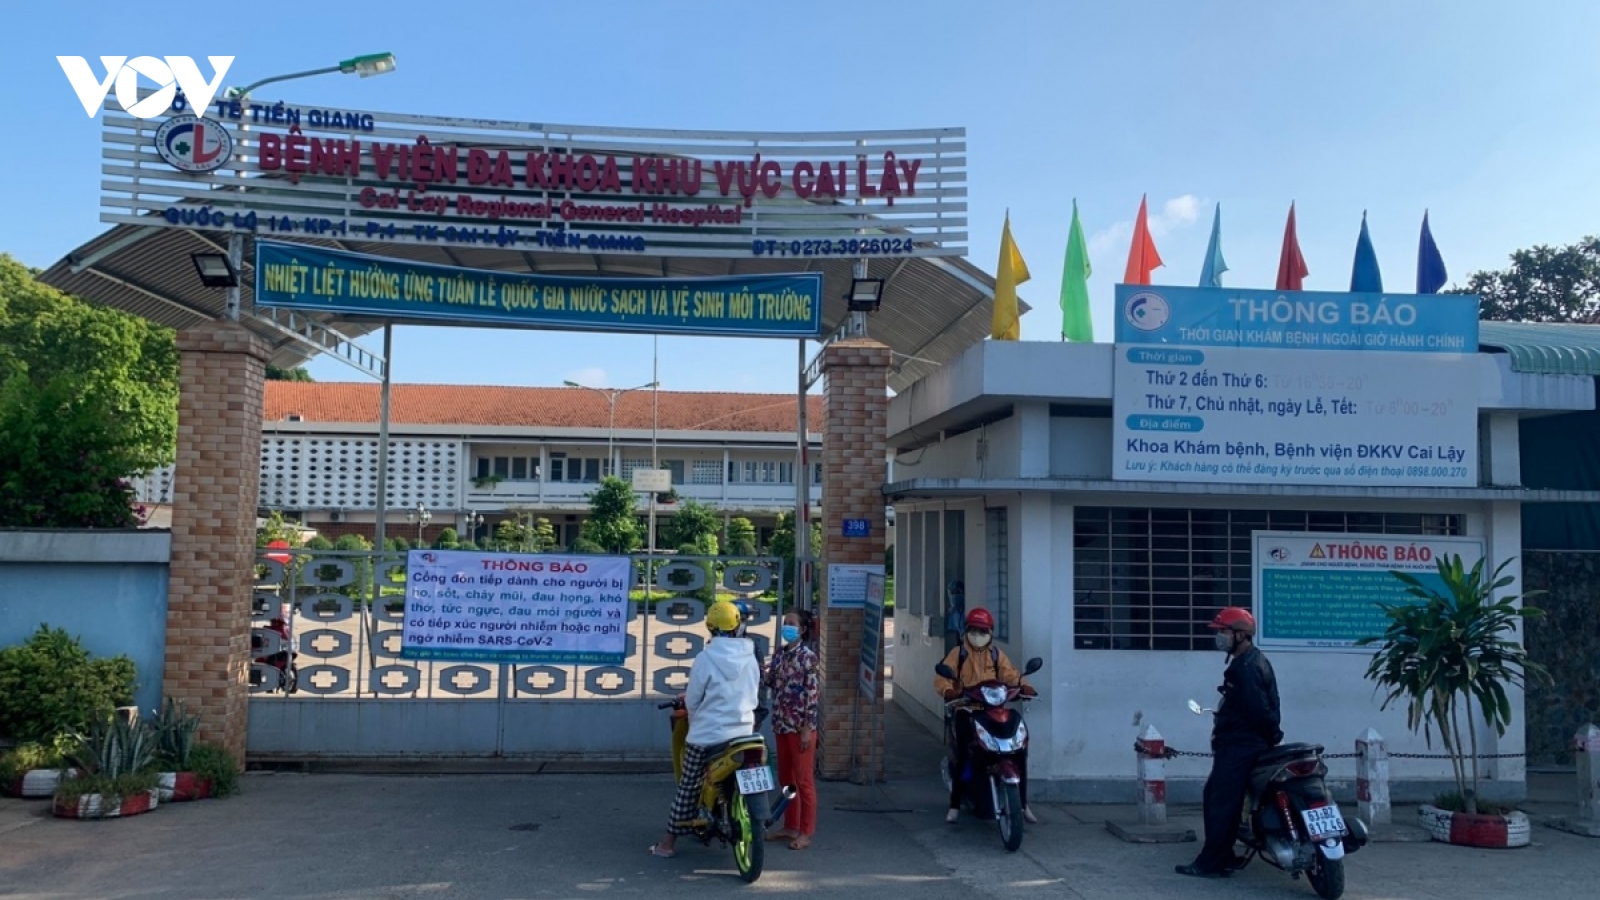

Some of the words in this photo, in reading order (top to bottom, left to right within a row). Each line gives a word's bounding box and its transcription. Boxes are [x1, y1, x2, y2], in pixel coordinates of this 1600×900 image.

[308, 109, 374, 131] GIANG
[258, 125, 361, 185] BỆNH
[372, 134, 457, 193] VIỆN
[526, 152, 621, 193] KHOA
[632, 156, 702, 195] KHU
[714, 153, 782, 208] VỰC
[792, 160, 847, 198] CAI
[858, 151, 922, 207] LẬY
[359, 186, 400, 208] Cai
[407, 190, 450, 216] Lay
[457, 194, 552, 219] Regional
[560, 200, 644, 222] General
[652, 203, 742, 227] Hospital
[164, 205, 226, 228] QUỐC
[587, 233, 645, 251] GIANG
[264, 258, 308, 299] NHIỆT
[312, 262, 345, 302] LIỆT
[350, 263, 400, 300] HƯỞNG
[502, 278, 538, 312] QUỐC
[543, 286, 565, 310] GIA
[570, 283, 607, 313] NƯỚC
[611, 289, 647, 320] SẠCH
[651, 285, 669, 316] VÀ
[672, 286, 690, 322] VỆ
[693, 290, 725, 319] SINH
[728, 286, 754, 320] MÔI
[758, 286, 812, 321] TRƯỜNG
[1228, 294, 1340, 324] THÔNG
[1351, 298, 1417, 326] BÁO
[1213, 328, 1243, 342] GIAN
[1246, 329, 1282, 344] KHÁM
[1286, 331, 1319, 347] BỆNH
[1139, 351, 1165, 361] Thời
[1167, 353, 1193, 363] gian
[1146, 370, 1175, 386] Thứ
[1179, 372, 1188, 386] 2
[1191, 369, 1218, 387] đến
[1222, 372, 1251, 388] Thứ
[1255, 374, 1268, 388] 6:
[1146, 394, 1175, 409] Thứ
[1180, 396, 1192, 412] 7,
[1195, 395, 1225, 412] Chủ
[1229, 398, 1264, 416] nhật,
[1268, 401, 1303, 417] ngày
[1331, 396, 1357, 414] Tết:
[1139, 418, 1159, 429] Địa
[1162, 417, 1191, 430] điểm
[1127, 438, 1169, 454] Khoa
[1174, 440, 1220, 455] Khám
[1225, 441, 1269, 459] bệnh,
[1275, 442, 1315, 460] Bệnh
[1320, 444, 1352, 461] viện
[1357, 445, 1403, 459] ĐKKV
[1407, 445, 1433, 460] Cai
[1437, 446, 1465, 463] Lậy
[1159, 461, 1192, 472] Khách
[1194, 462, 1219, 475] hàng
[1221, 462, 1233, 473] có
[1294, 464, 1321, 475] trước
[1323, 466, 1341, 478] qua
[1343, 463, 1356, 476] số
[1358, 465, 1378, 478] điện
[1380, 465, 1405, 478] thoại
[1326, 540, 1388, 560] THÔNG
[1394, 542, 1432, 562] BÁO
[481, 558, 544, 572] THÔNG
[549, 560, 588, 573] BÁO
[412, 570, 446, 586] Cổng
[451, 572, 475, 584] đón
[479, 573, 502, 587] tiếp
[507, 576, 538, 587] dành
[542, 577, 566, 587] cho
[570, 577, 607, 590] người
[611, 578, 623, 591] bị
[500, 590, 526, 602] mũi,
[531, 591, 555, 601] đau
[599, 593, 622, 603] khó
[508, 606, 531, 616] đau
[564, 608, 602, 619] người
[607, 608, 621, 618] và
[409, 618, 425, 627] có
[428, 617, 451, 631] tiếp
[454, 619, 476, 629] xúc
[480, 620, 517, 632] người
[520, 620, 557, 631] nhiễm
[560, 622, 591, 634] hoặc
[594, 623, 620, 635] nghi
[437, 633, 474, 644] nhiễm
[478, 635, 553, 647] SARS-CoV-2
